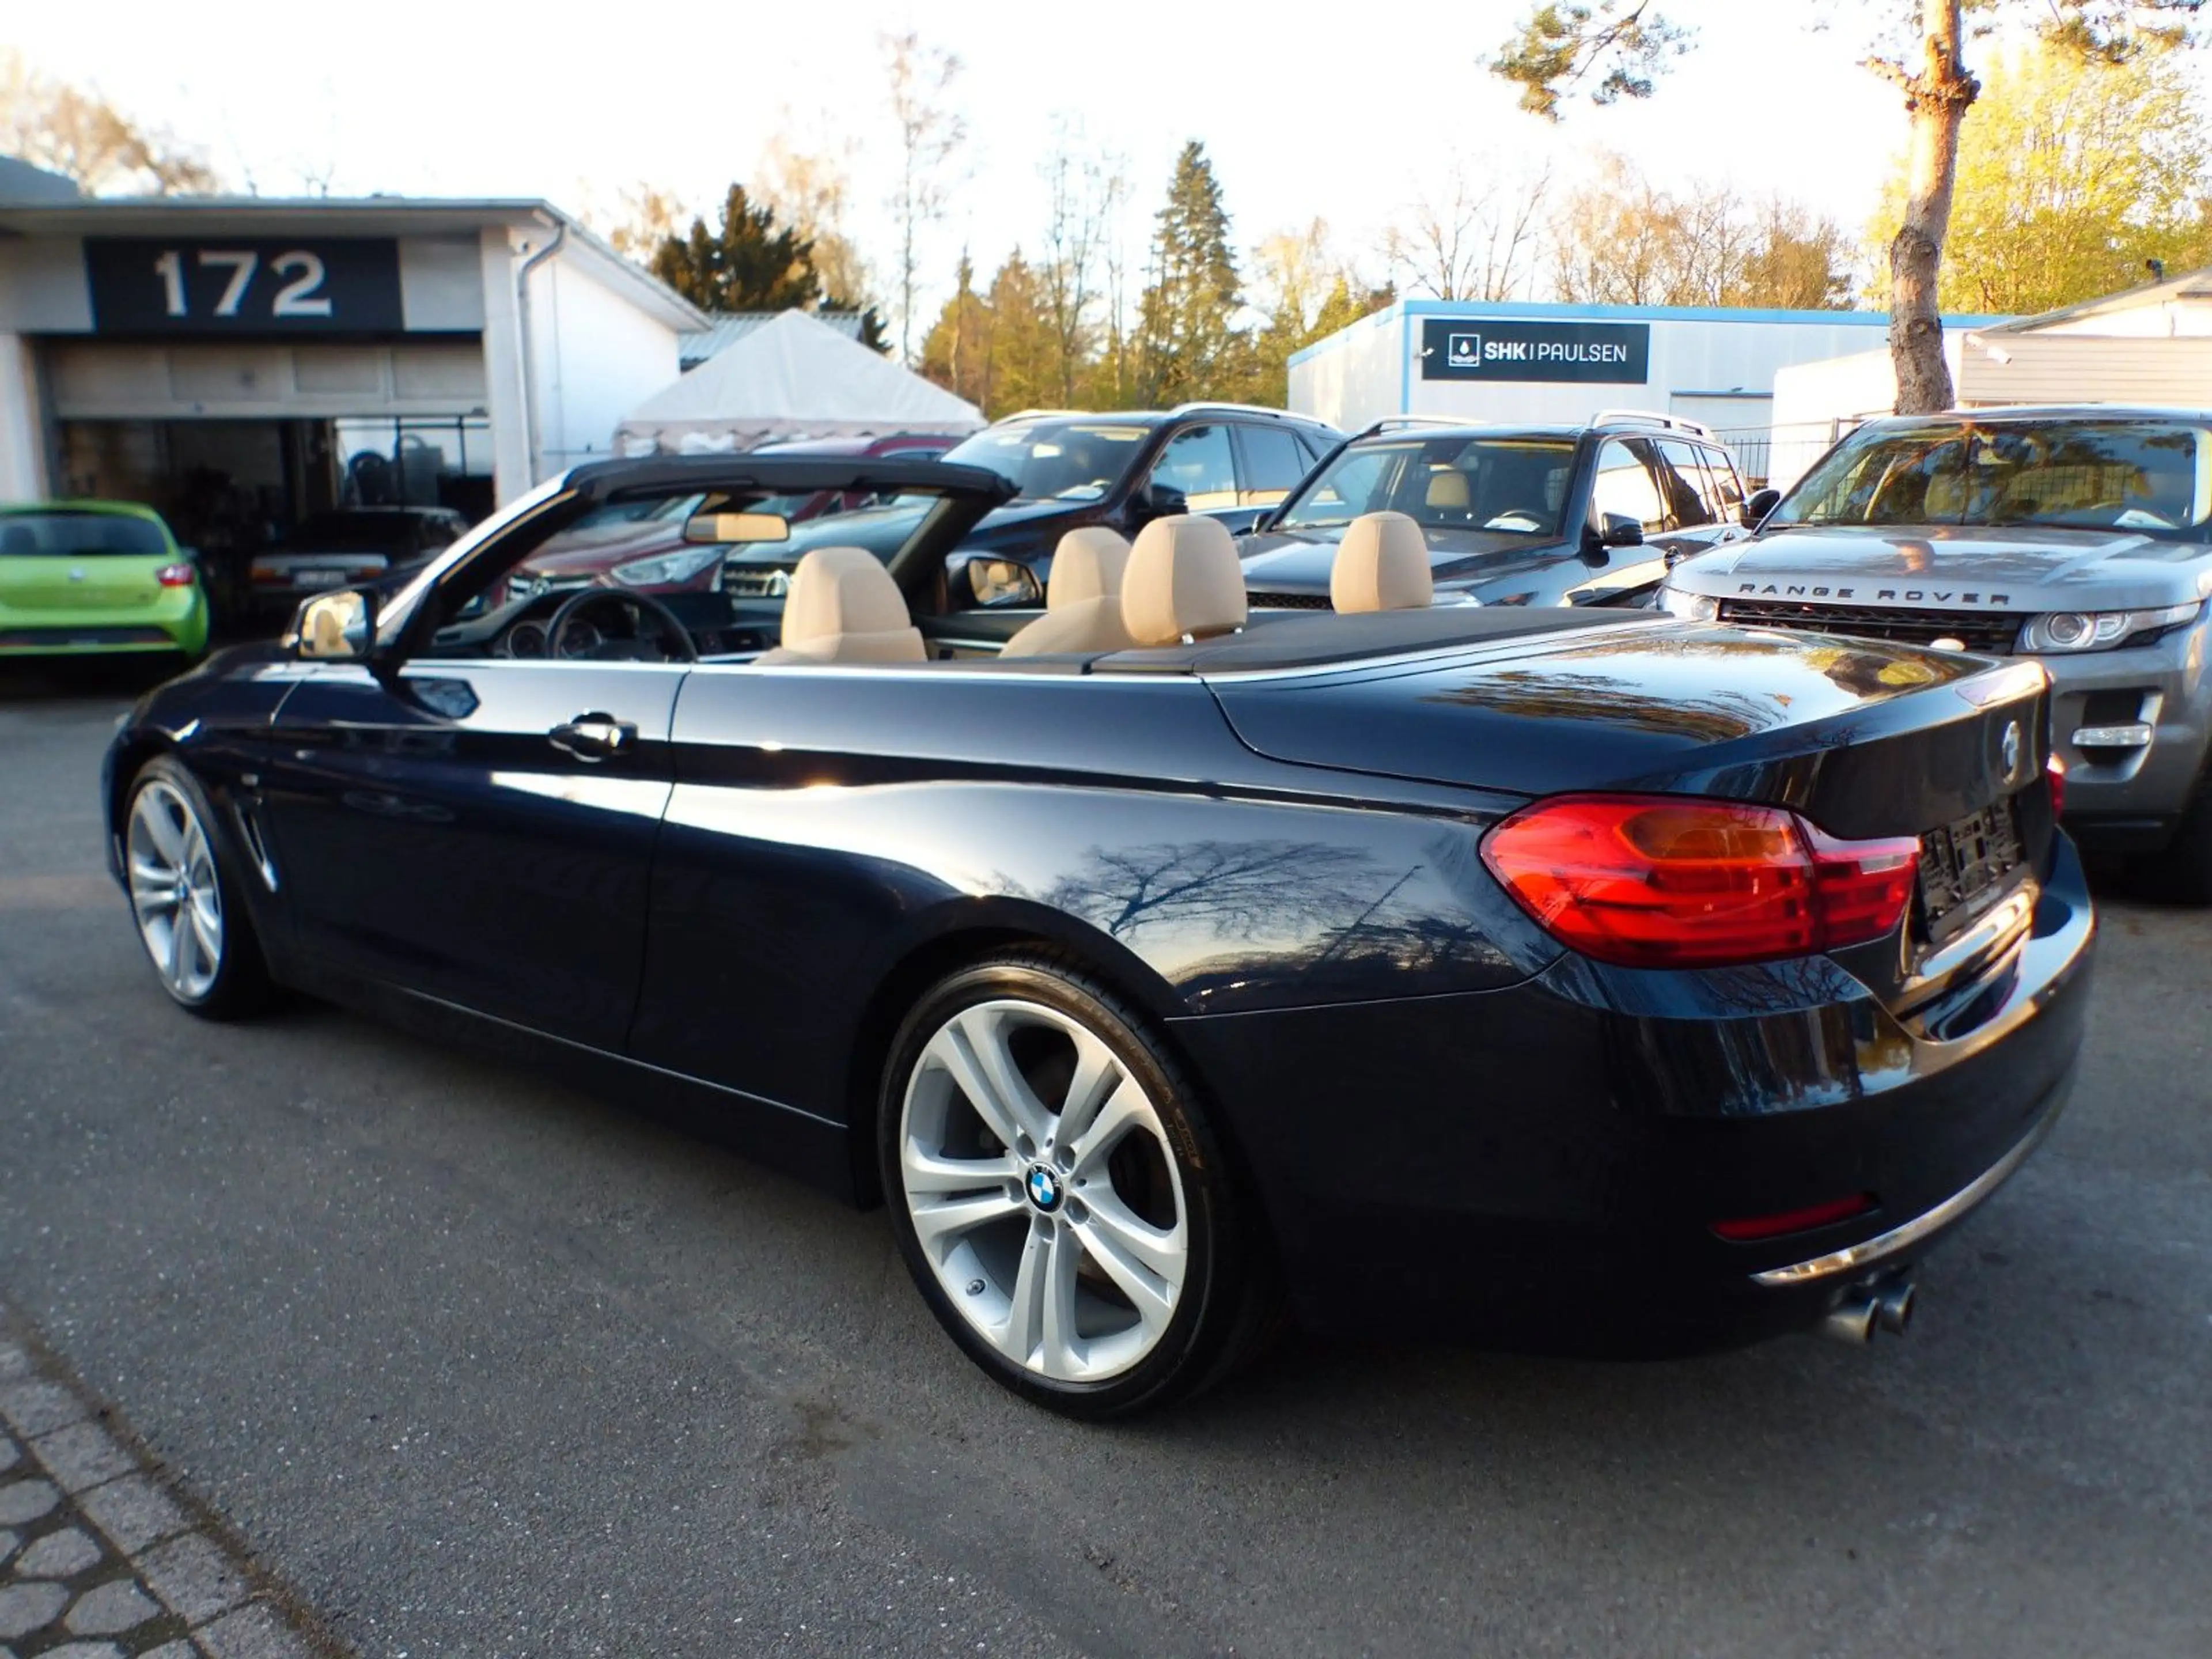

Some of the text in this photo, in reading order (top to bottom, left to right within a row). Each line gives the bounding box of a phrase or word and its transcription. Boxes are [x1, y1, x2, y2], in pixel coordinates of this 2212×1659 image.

[156, 250, 332, 317] 172
[1484, 342, 1627, 362] SHK PAULSEN
[1739, 583, 2010, 605] RANGE ROVER
